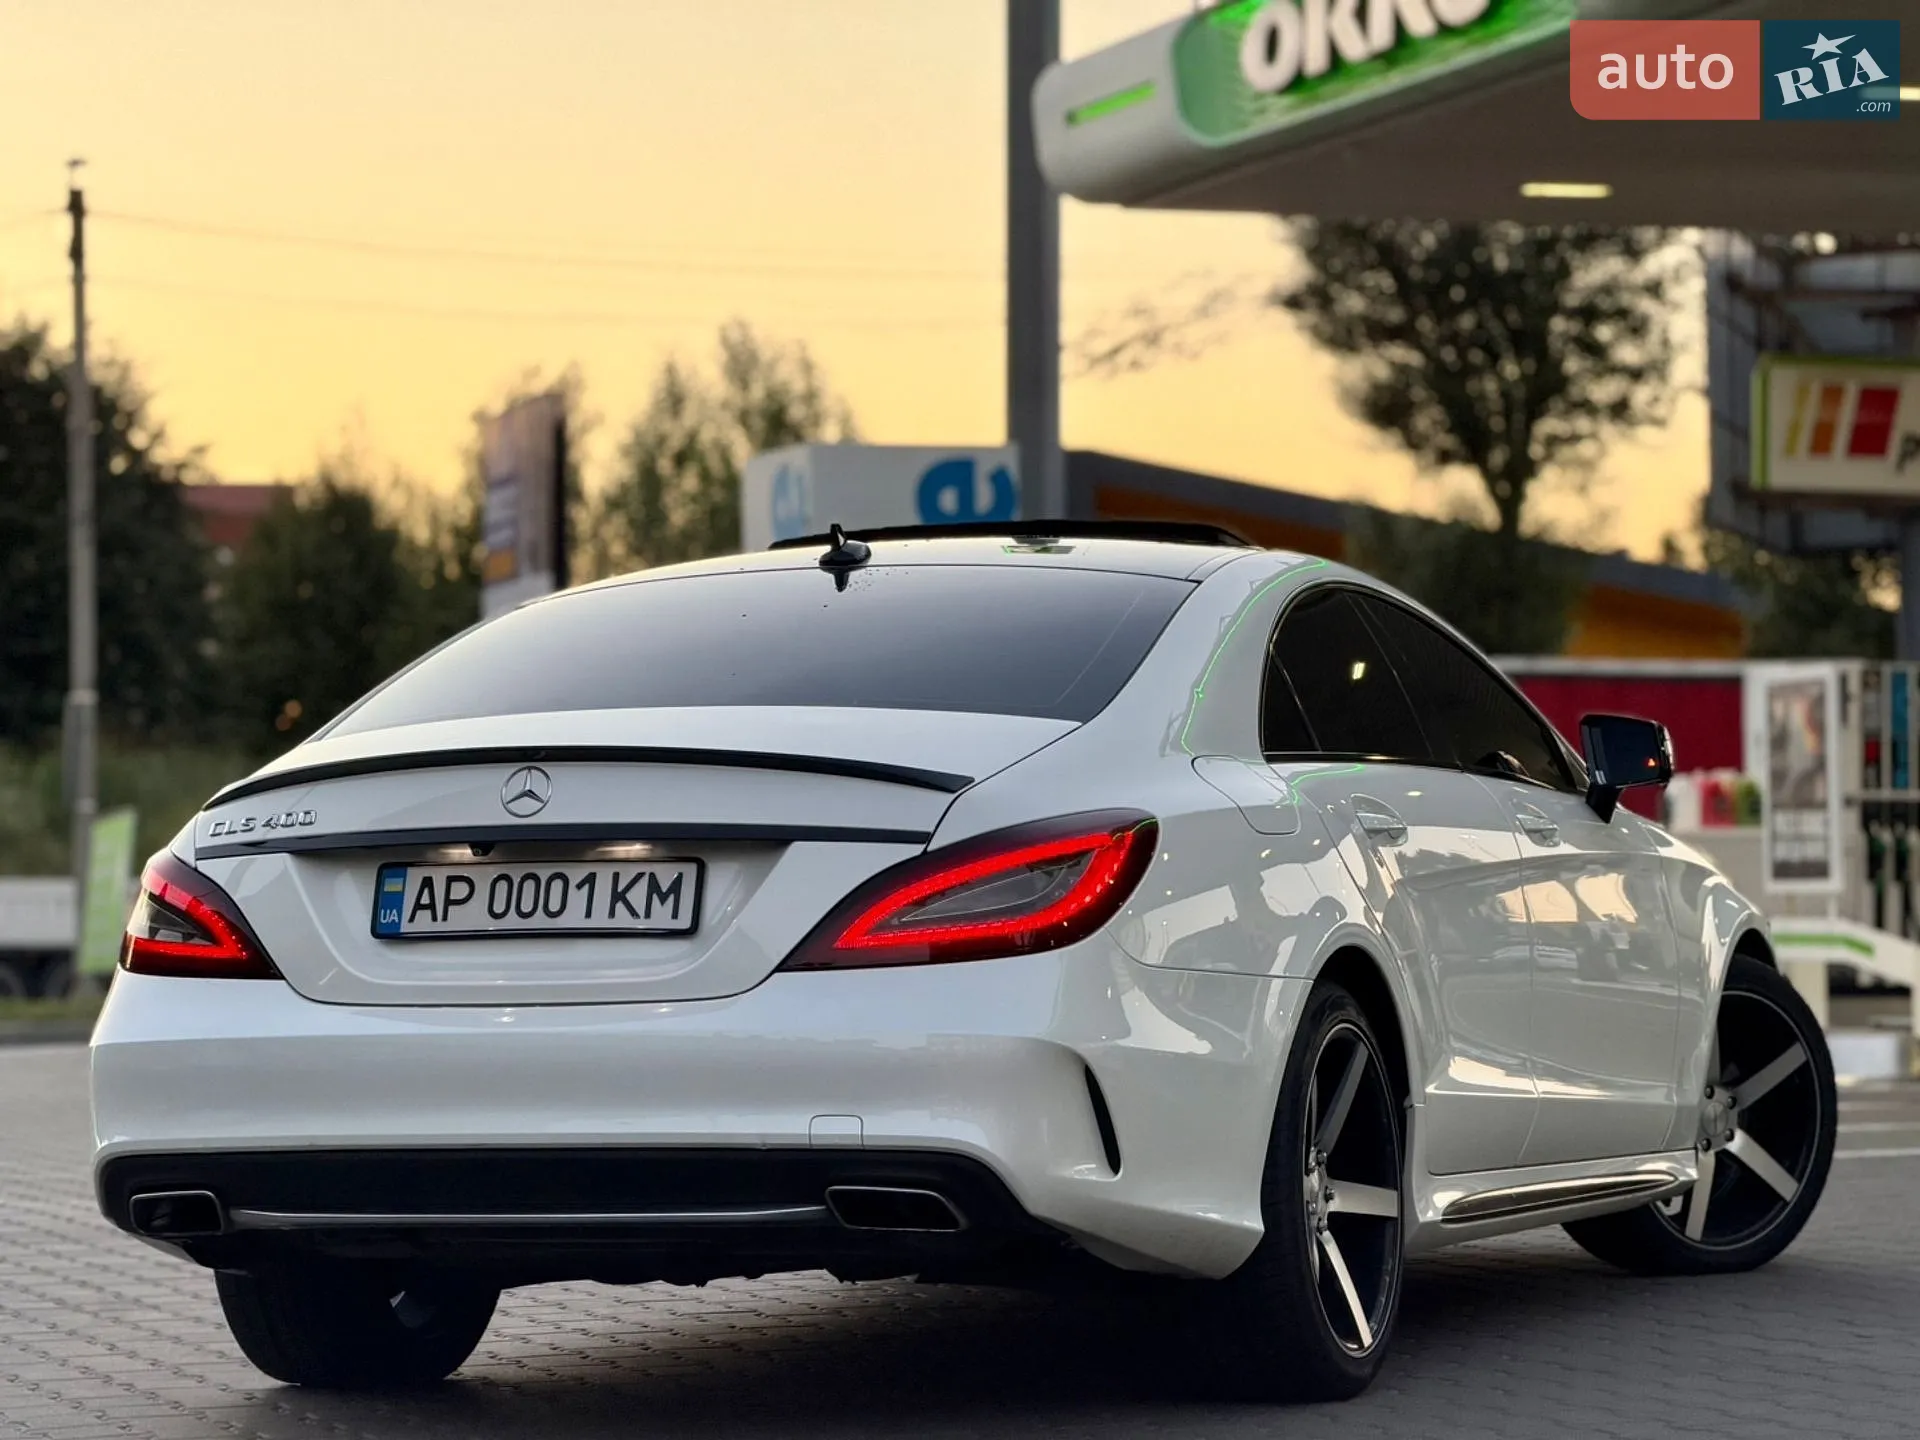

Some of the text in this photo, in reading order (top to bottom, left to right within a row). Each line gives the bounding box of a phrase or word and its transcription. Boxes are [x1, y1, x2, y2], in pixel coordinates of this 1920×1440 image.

[208, 809, 317, 837] CLS 400
[407, 871, 683, 923] AP 0001 KM
[380, 909, 399, 924] UA
